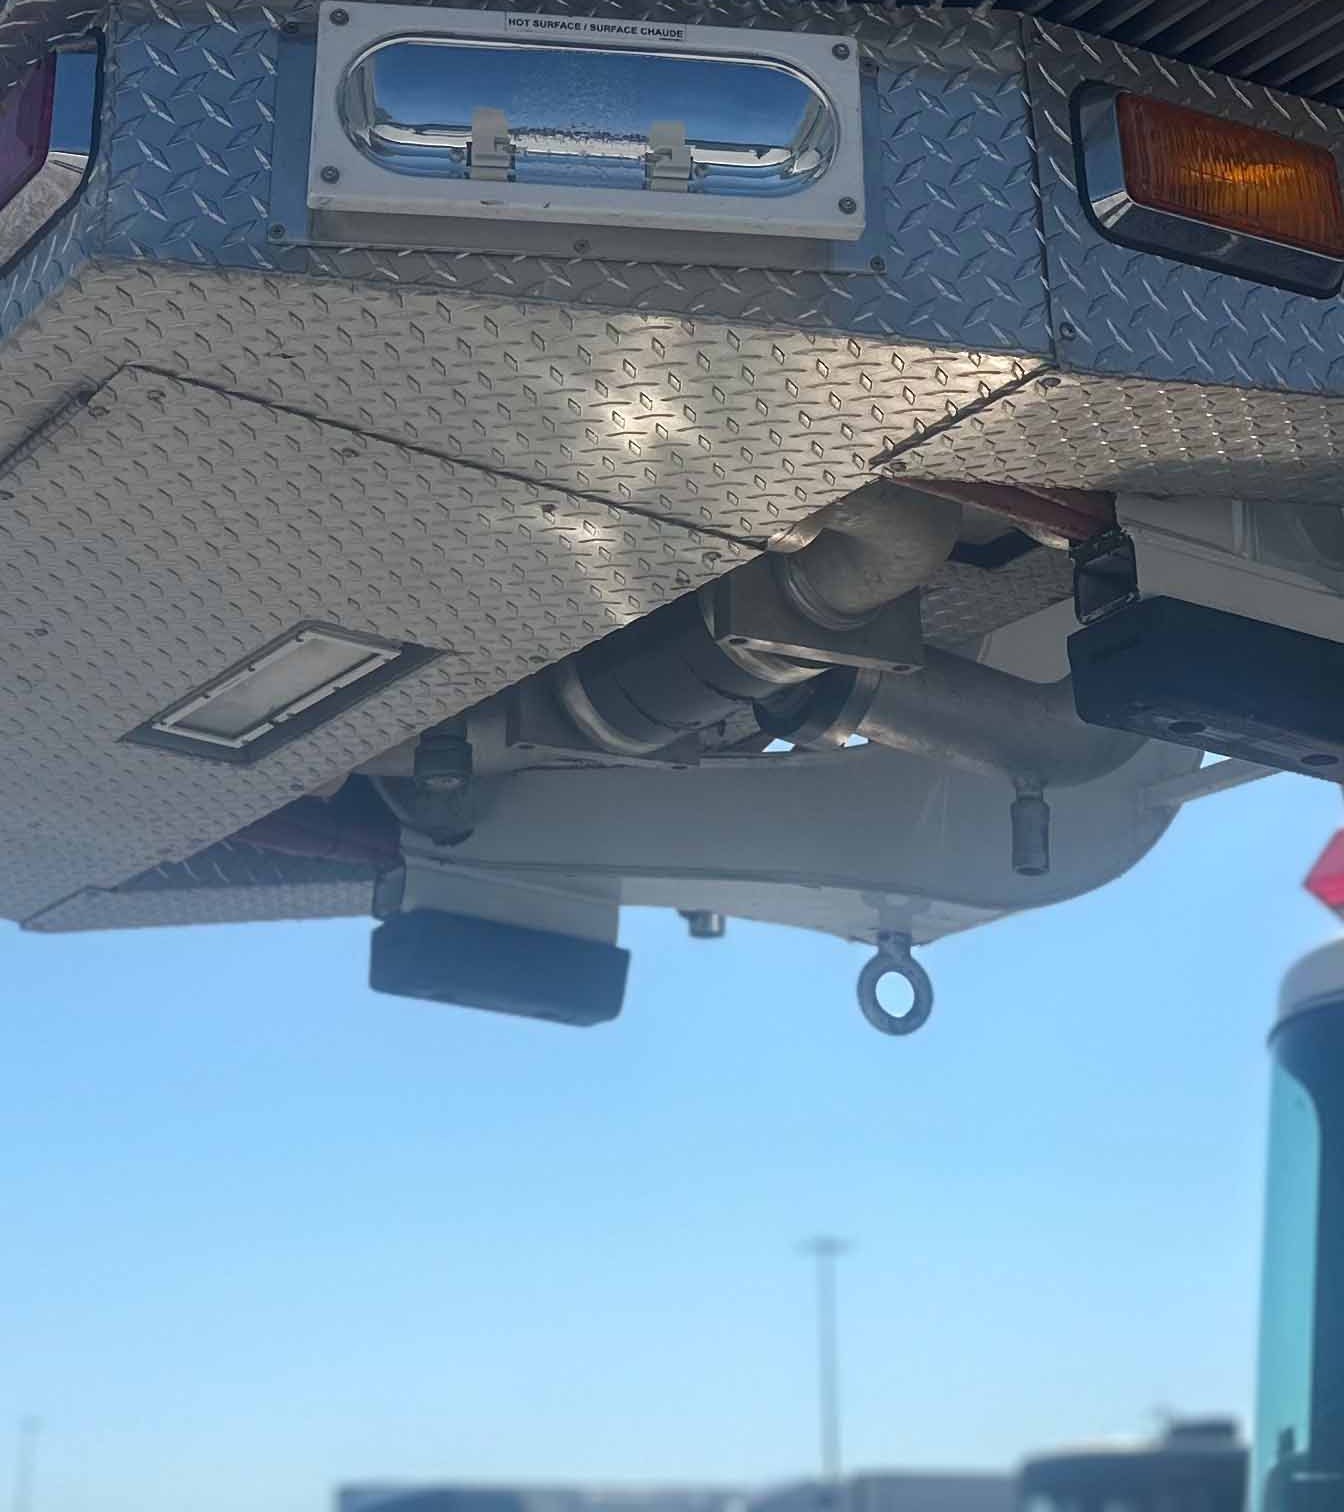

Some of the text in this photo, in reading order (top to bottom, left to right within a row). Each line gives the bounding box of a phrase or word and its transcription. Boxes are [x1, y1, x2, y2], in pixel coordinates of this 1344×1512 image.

[508, 17, 530, 28] HOT
[532, 19, 581, 31] SURFACE
[590, 23, 638, 35] SURFACE
[640, 27, 684, 39] CHAUDE
